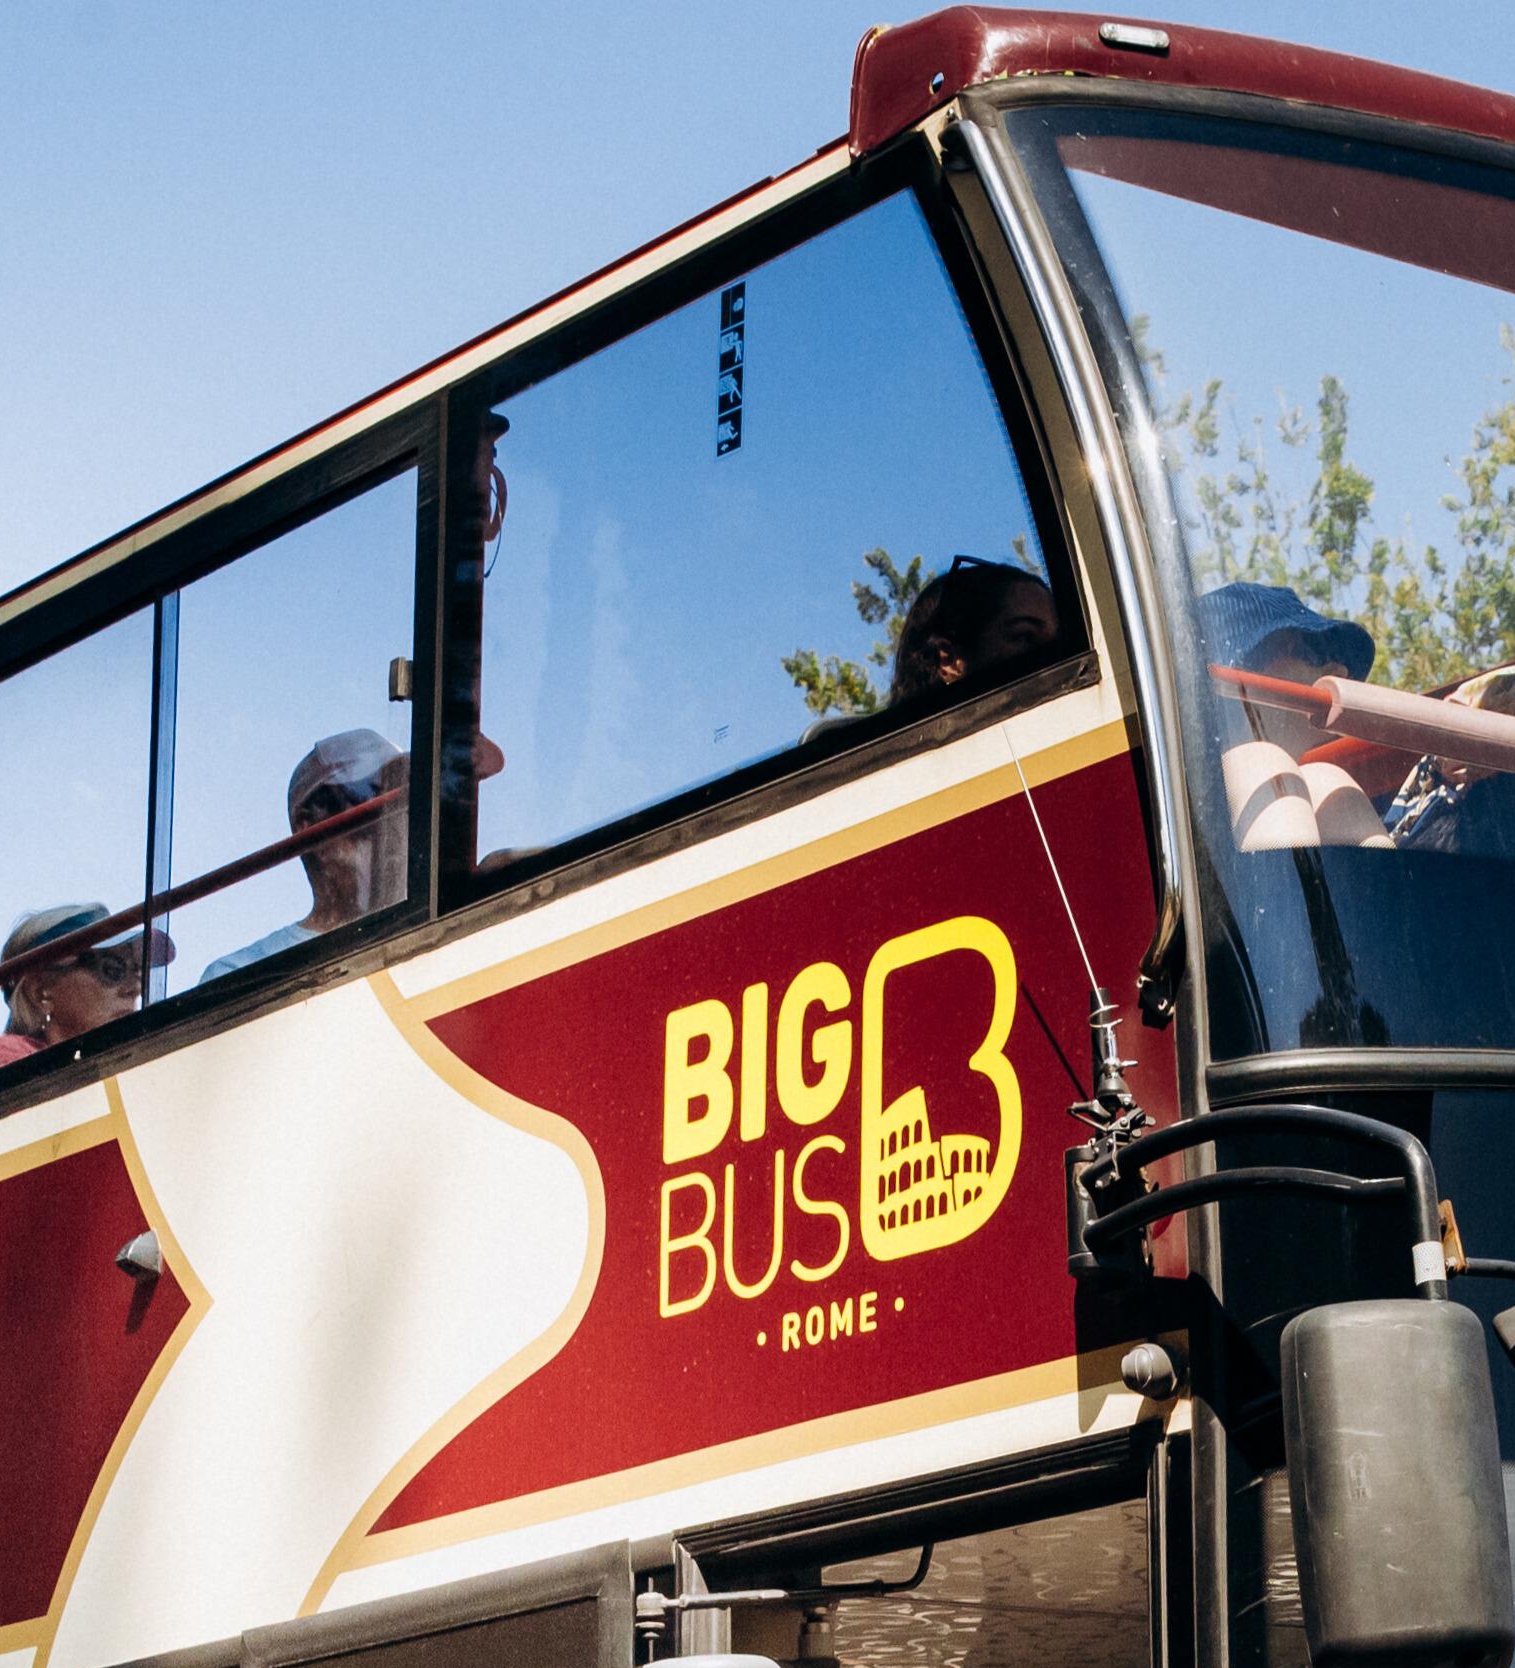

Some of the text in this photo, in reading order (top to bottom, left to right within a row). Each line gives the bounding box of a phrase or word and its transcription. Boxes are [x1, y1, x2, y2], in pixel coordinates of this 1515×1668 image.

[663, 961, 853, 1165] BIG
[659, 1135, 851, 1319] BUS
[781, 1291, 878, 1352] ROME
